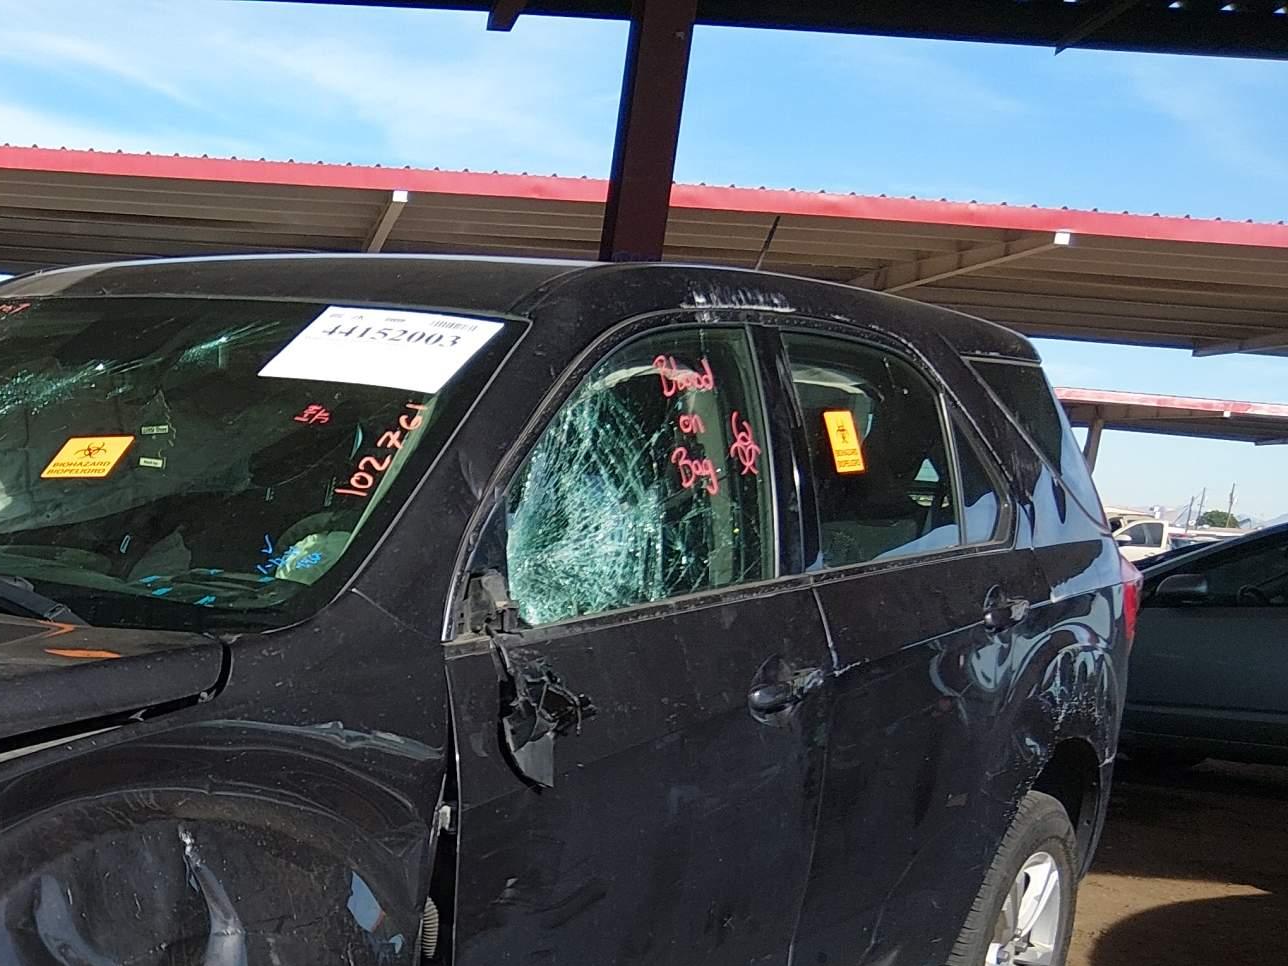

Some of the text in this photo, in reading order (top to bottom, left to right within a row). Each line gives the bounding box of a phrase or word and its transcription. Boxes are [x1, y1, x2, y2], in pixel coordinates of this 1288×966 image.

[323, 324, 462, 347] 44152003
[652, 355, 713, 397] Blood
[679, 414, 705, 433] on
[671, 446, 719, 495] Bag
